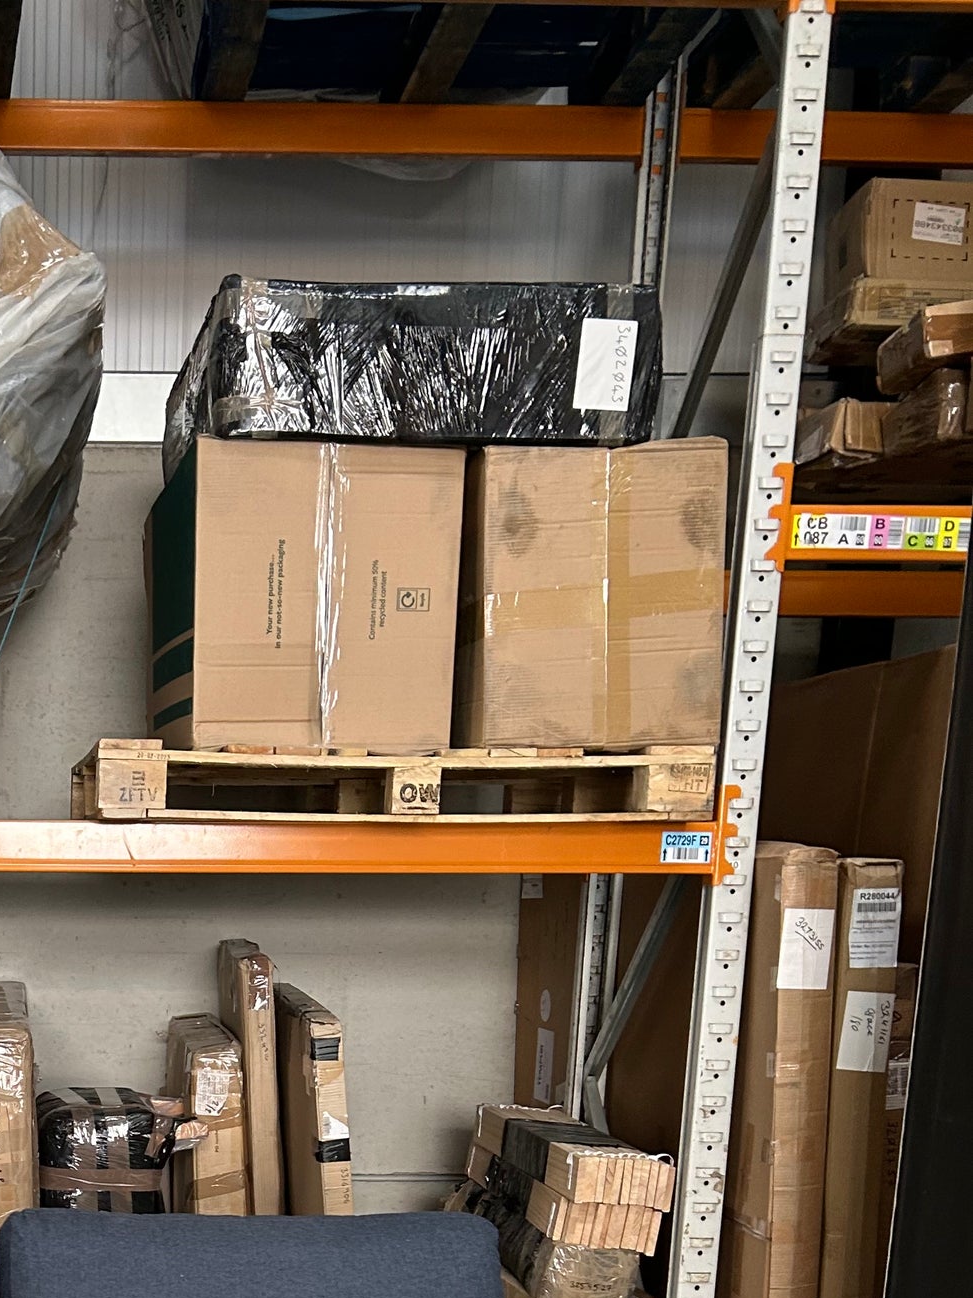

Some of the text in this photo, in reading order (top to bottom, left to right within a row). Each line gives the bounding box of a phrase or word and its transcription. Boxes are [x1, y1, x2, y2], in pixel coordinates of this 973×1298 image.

[807, 516, 828, 530] CB
[875, 518, 885, 530] B
[944, 520, 955, 532] D
[837, 535, 849, 545] A
[907, 535, 918, 547] C
[665, 834, 698, 846] C2729F
[859, 891, 895, 900] R280044
